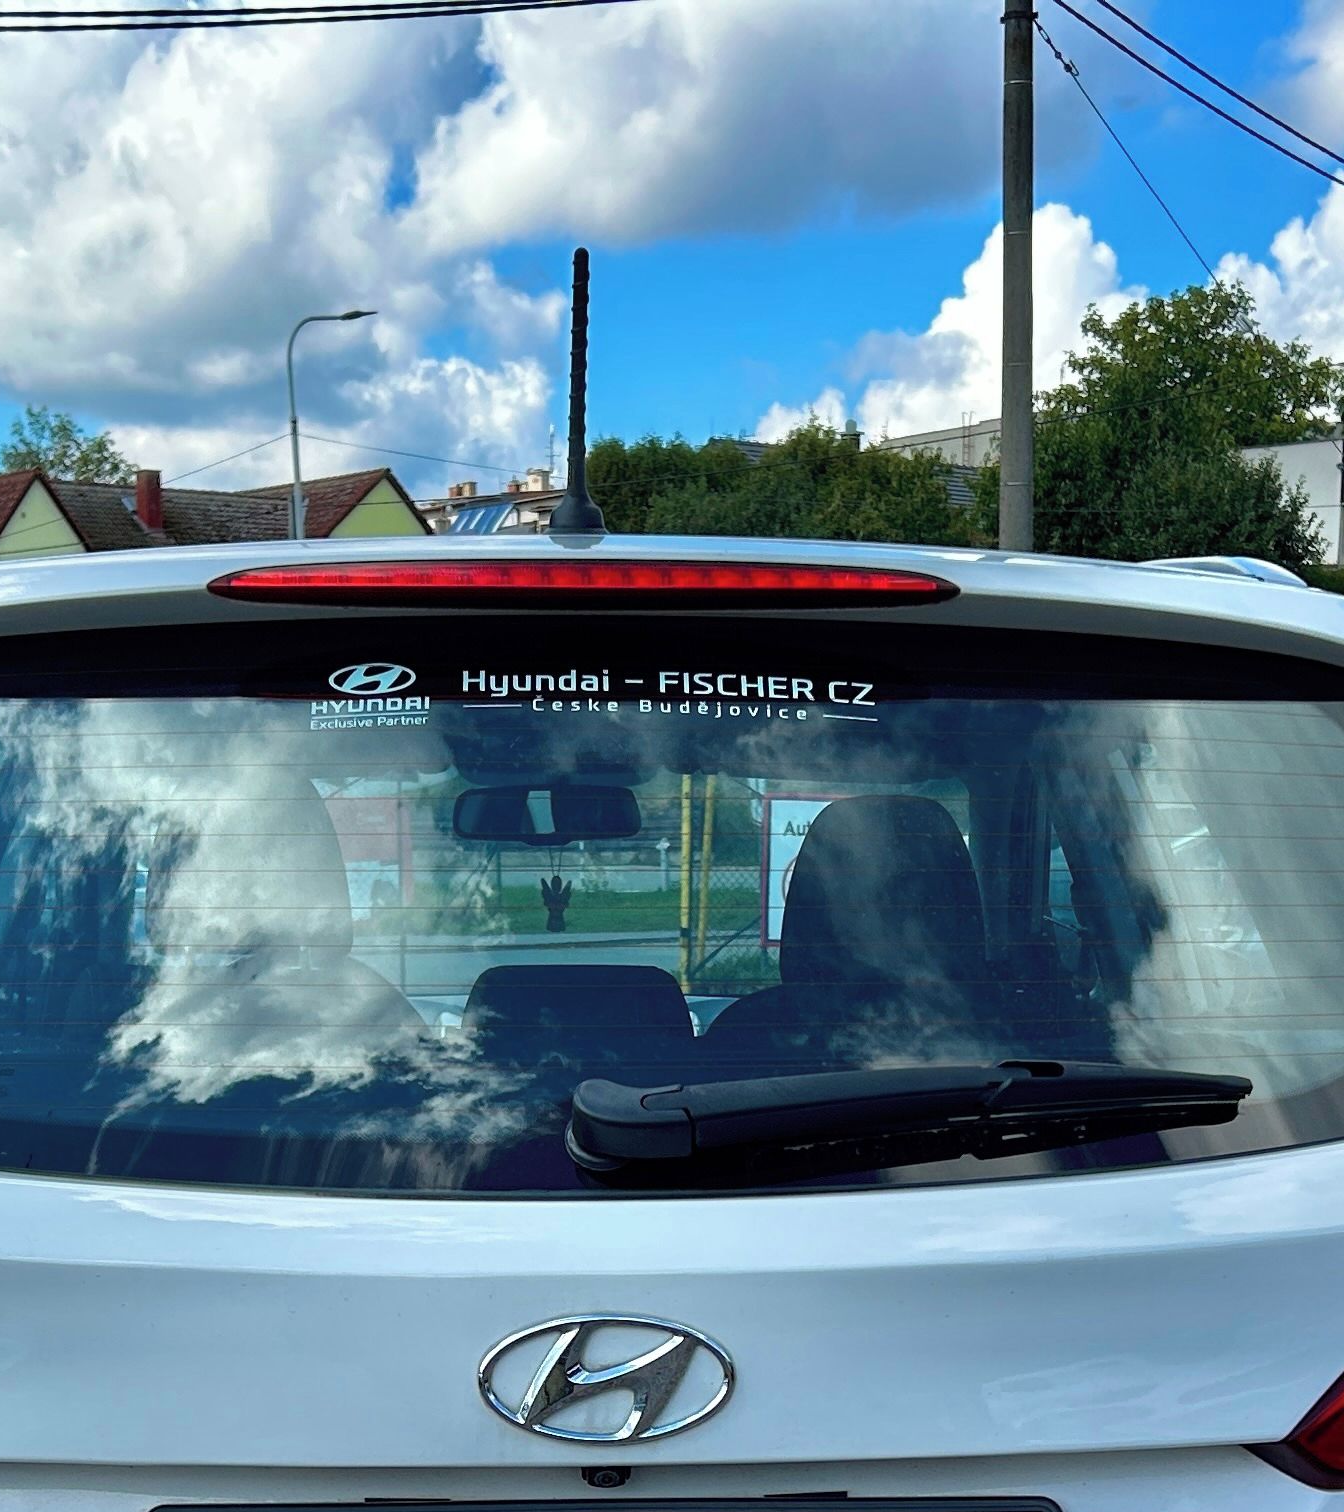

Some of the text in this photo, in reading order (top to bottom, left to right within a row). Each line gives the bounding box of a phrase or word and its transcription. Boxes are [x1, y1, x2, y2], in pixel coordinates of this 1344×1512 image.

[461, 668, 610, 698] Hyundai
[658, 671, 816, 701] FISCHER
[828, 681, 876, 706] CZ
[310, 696, 431, 715] HYUNDAI
[638, 699, 807, 720] Budějovice
[310, 715, 429, 731] Exclusive Partner
